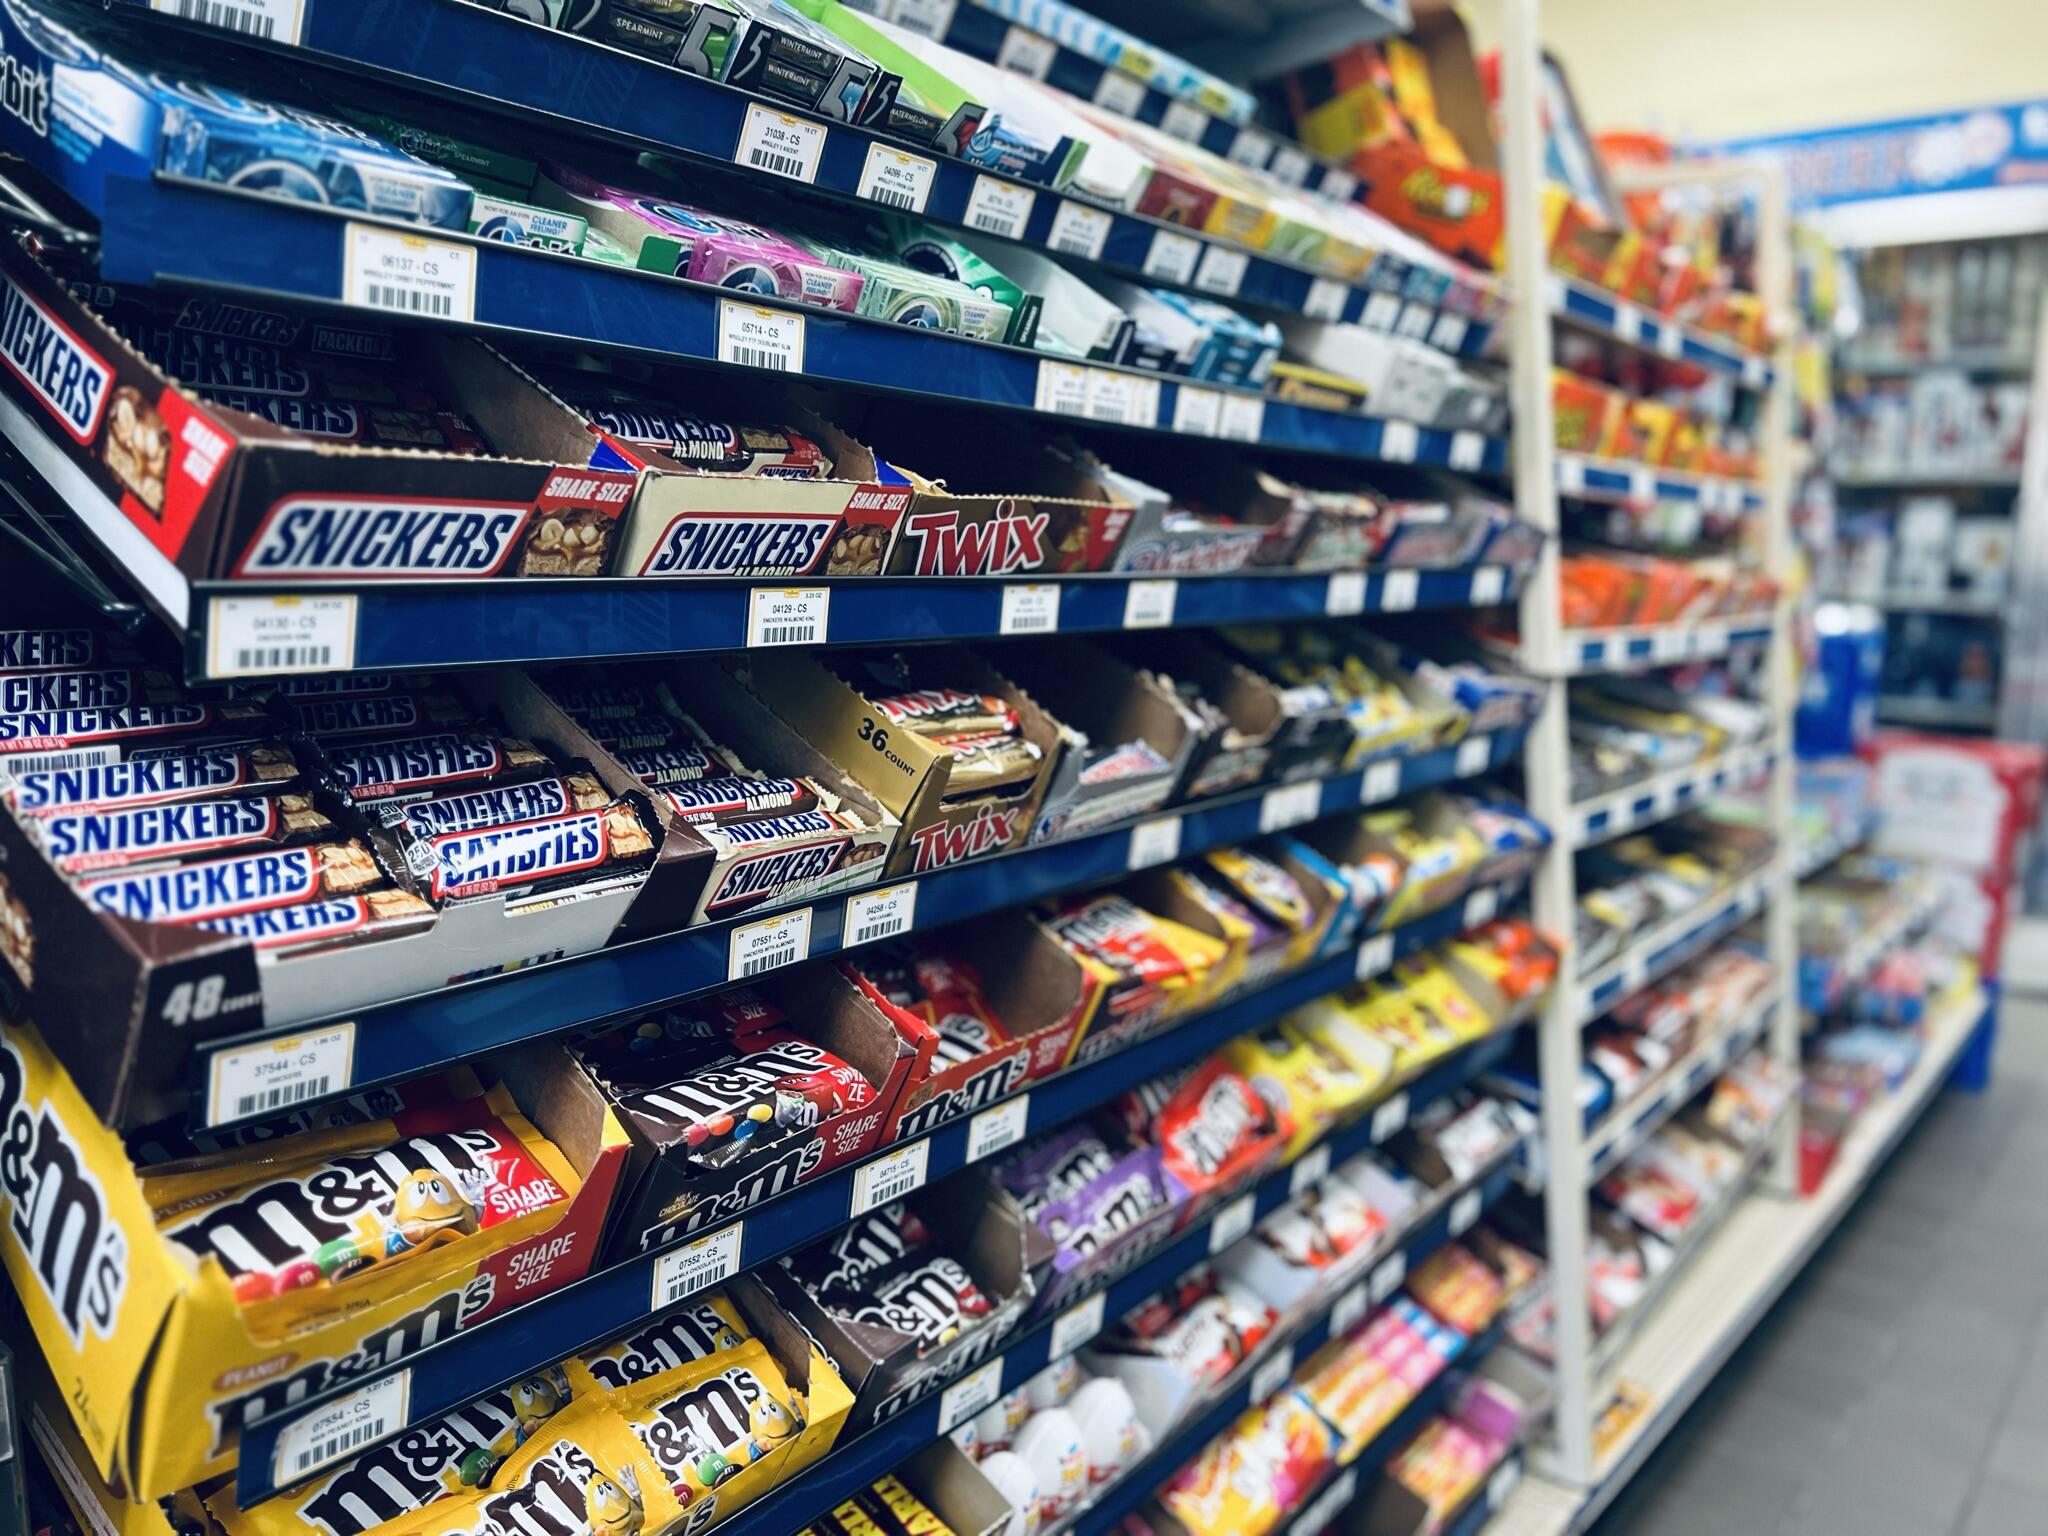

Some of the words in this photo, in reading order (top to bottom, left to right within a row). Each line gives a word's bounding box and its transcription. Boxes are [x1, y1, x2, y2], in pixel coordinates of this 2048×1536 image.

[616, 17, 663, 39] SPEARMINT
[781, 36, 822, 60] WINTERMINT
[768, 63, 810, 87] WINTERMINT
[789, 134, 801, 145] CS
[904, 172, 914, 183] CS
[532, 215, 568, 229] CLEANER
[423, 261, 439, 276] CS
[415, 277, 456, 291] PEPPERMINT
[806, 278, 833, 289] CLEANER
[178, 301, 301, 345] SNICKERS
[742, 322, 762, 335] 05714
[768, 327, 779, 339] CS
[599, 411, 733, 442] SNICKERS
[672, 440, 724, 461] ALMOND
[545, 476, 597, 500] SHARE
[596, 483, 632, 503] SIZE
[850, 491, 884, 510] SHARE
[883, 493, 908, 511] SIZE
[256, 507, 517, 570] SNICKERS
[652, 522, 829, 573] SNICKERS
[906, 499, 1049, 576] Twix
[773, 604, 792, 614] 04129
[797, 603, 807, 613] CS
[299, 616, 316, 629] CS
[0, 702, 203, 739] SNICKERS
[618, 734, 666, 750] ALMOND
[857, 717, 889, 752] 36
[885, 750, 916, 777] COUNT
[340, 742, 494, 787] SATISFIES
[657, 766, 703, 784] ALMOND
[22, 753, 237, 808] SNICKERS
[677, 777, 795, 807] SNICKERS
[409, 779, 562, 837] SNICKERS
[746, 793, 792, 813] ALMOND
[50, 797, 265, 857] SNICKERS
[711, 811, 830, 844] NICKERS
[911, 803, 1020, 873] Twix
[408, 843, 430, 863] 250
[93, 851, 308, 920] SNICKERS
[719, 847, 836, 900] SNICKERS
[888, 900, 898, 910] CS
[752, 936, 772, 948] 07551
[778, 929, 788, 941] CS
[162, 974, 225, 1027] 48
[743, 1003, 768, 1020] SIZE
[254, 1061, 289, 1078] 37544
[299, 1053, 316, 1066] CS
[848, 1083, 867, 1102] ZE
[834, 1113, 882, 1143] SHARE
[836, 1134, 864, 1156] SIZE
[900, 1159, 910, 1169] CS
[155, 1190, 225, 1221] PEANUT
[490, 1179, 562, 1214] SHARE
[659, 1194, 701, 1218] CHOCOLATE
[507, 1232, 576, 1277] SHARE
[679, 1254, 701, 1271] 07552
[707, 1246, 718, 1258] CS
[689, 1259, 717, 1274] CHOCOLATE
[515, 1261, 555, 1290] SIZE
[223, 1356, 289, 1386] PEANUT
[312, 1411, 344, 1433] 07554
[354, 1399, 370, 1414] CS
